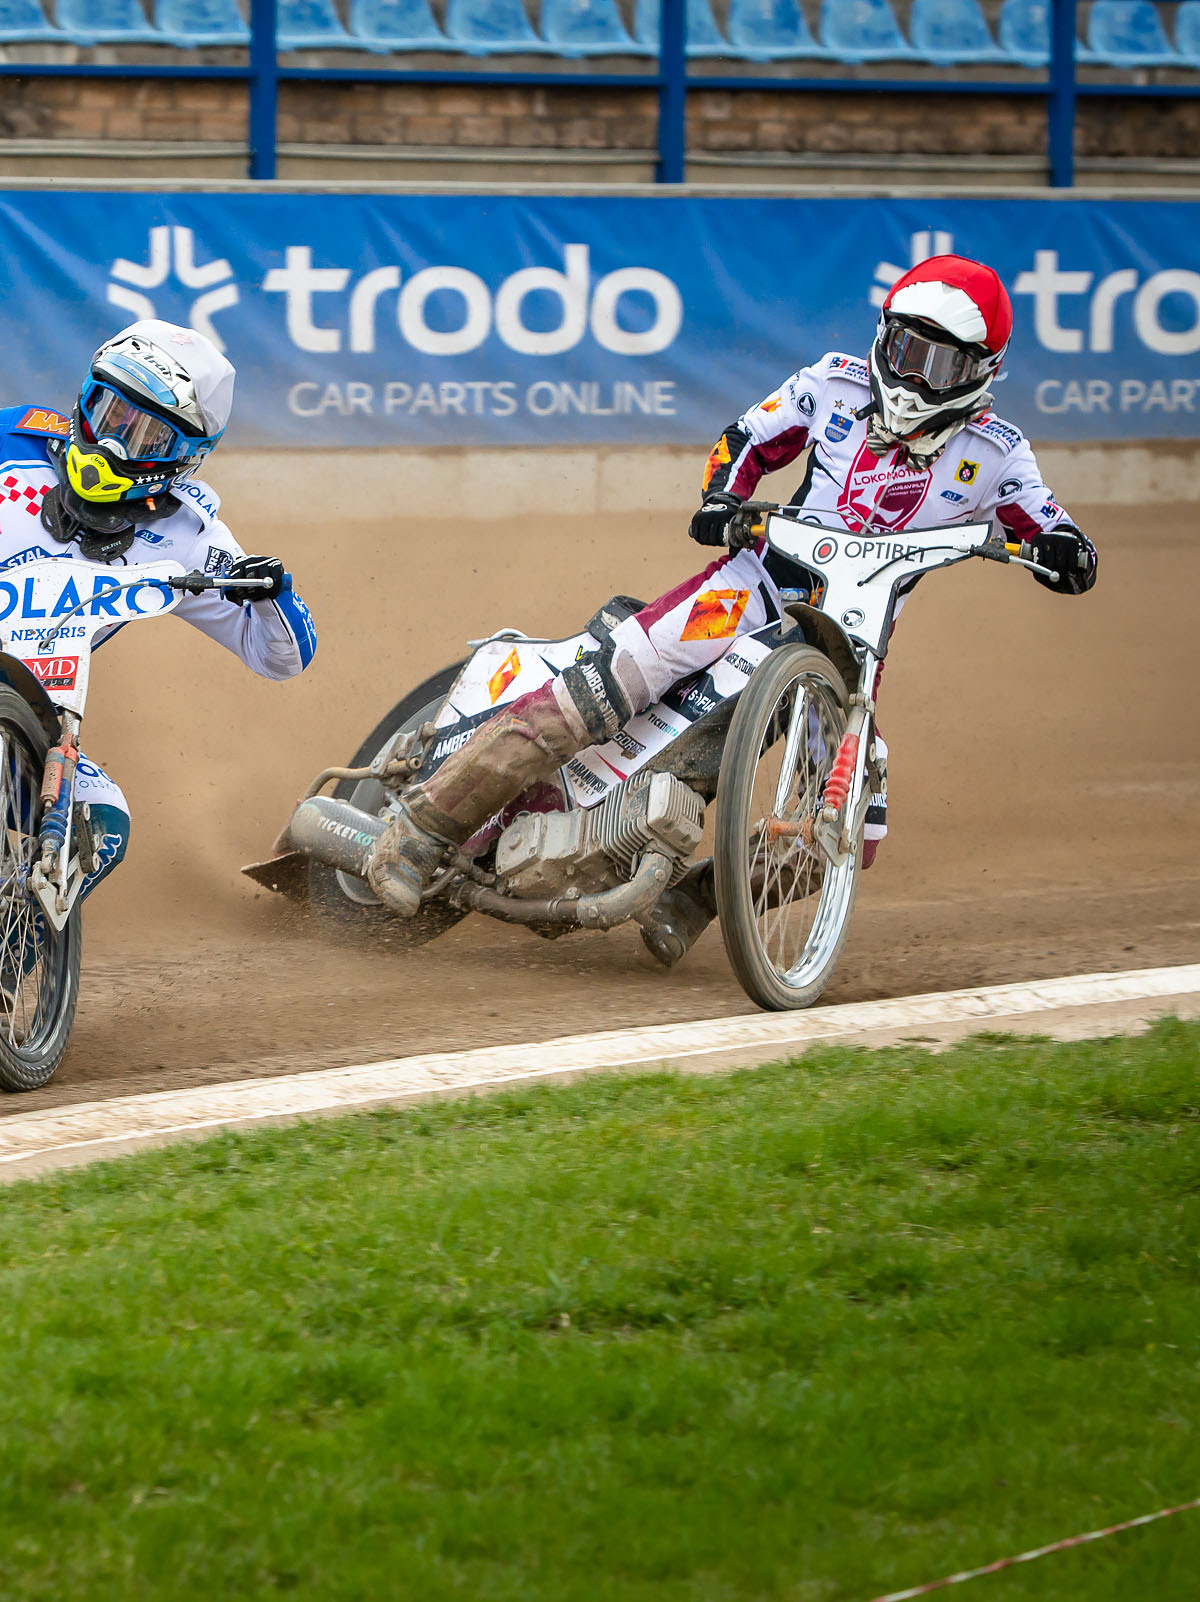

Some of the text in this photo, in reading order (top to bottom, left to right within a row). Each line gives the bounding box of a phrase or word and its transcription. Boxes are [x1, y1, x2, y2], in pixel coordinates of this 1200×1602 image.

[263, 244, 683, 356] trodo
[287, 380, 677, 417] CAR PARTS ONLINE
[1035, 379, 1112, 415] CAR
[7, 547, 46, 568] STAL
[844, 541, 926, 563] OPTIBET
[11, 626, 86, 641] NEXORIS
[31, 658, 76, 678] MD
[580, 663, 607, 701] AMBER
[570, 773, 596, 797] FAMILY
